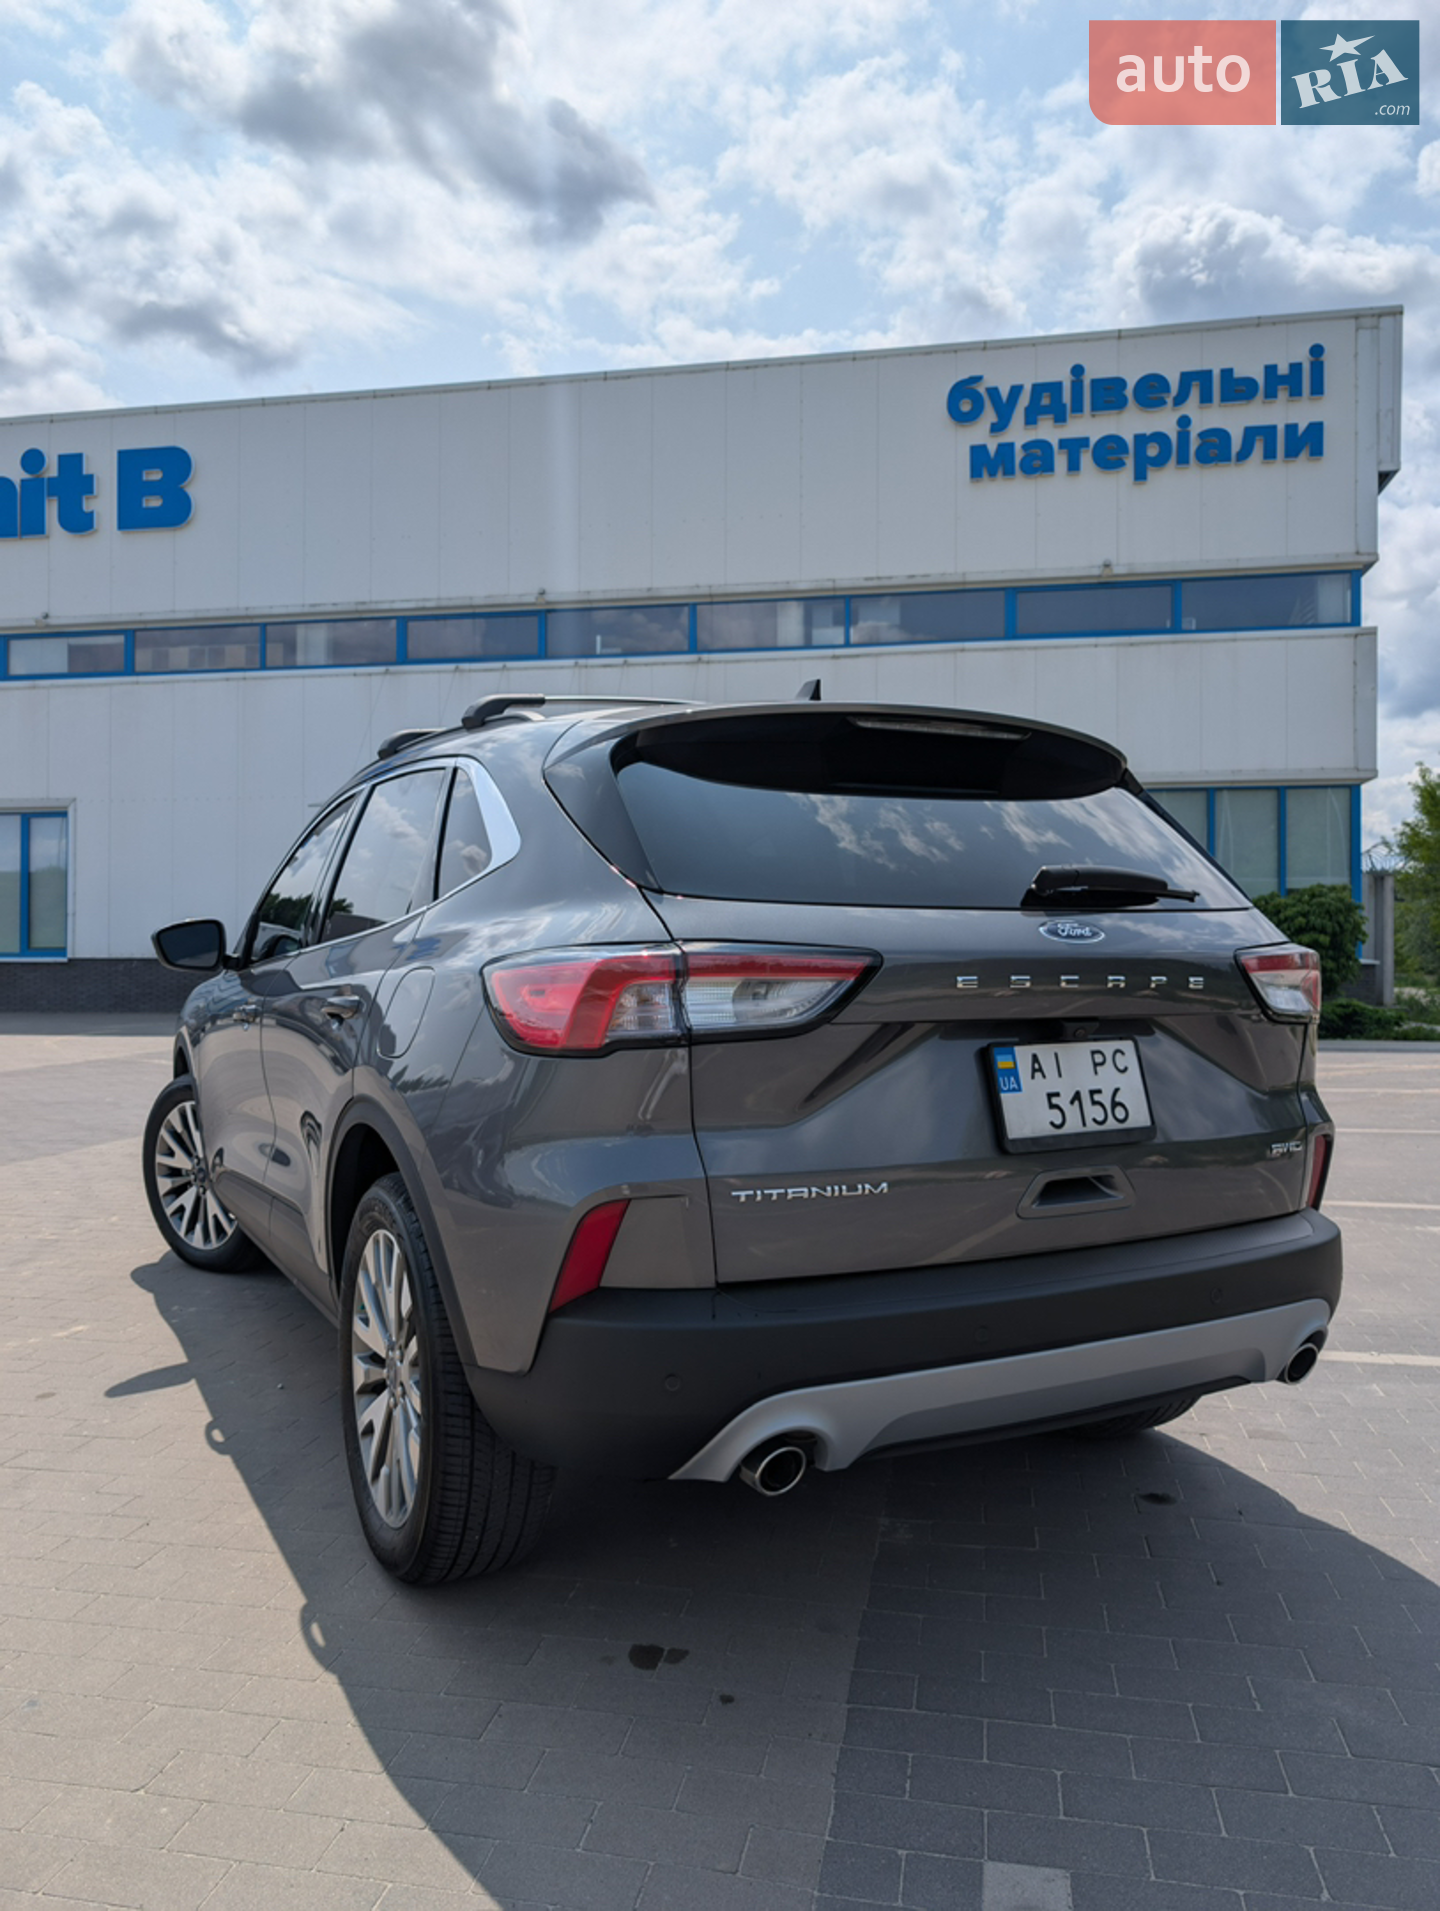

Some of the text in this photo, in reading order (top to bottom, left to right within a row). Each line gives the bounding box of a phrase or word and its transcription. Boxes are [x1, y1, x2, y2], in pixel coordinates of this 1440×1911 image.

[946, 343, 1325, 436] будівельні
[969, 414, 1325, 483] матеріали
[116, 445, 193, 532] B
[1057, 923, 1092, 937] Ford
[956, 975, 1205, 989] ESCAPE
[1031, 1048, 1129, 1080] AI PC
[1000, 1077, 1019, 1091] UA
[1046, 1087, 1130, 1130] 5156
[731, 1182, 889, 1203] TITANIUM
